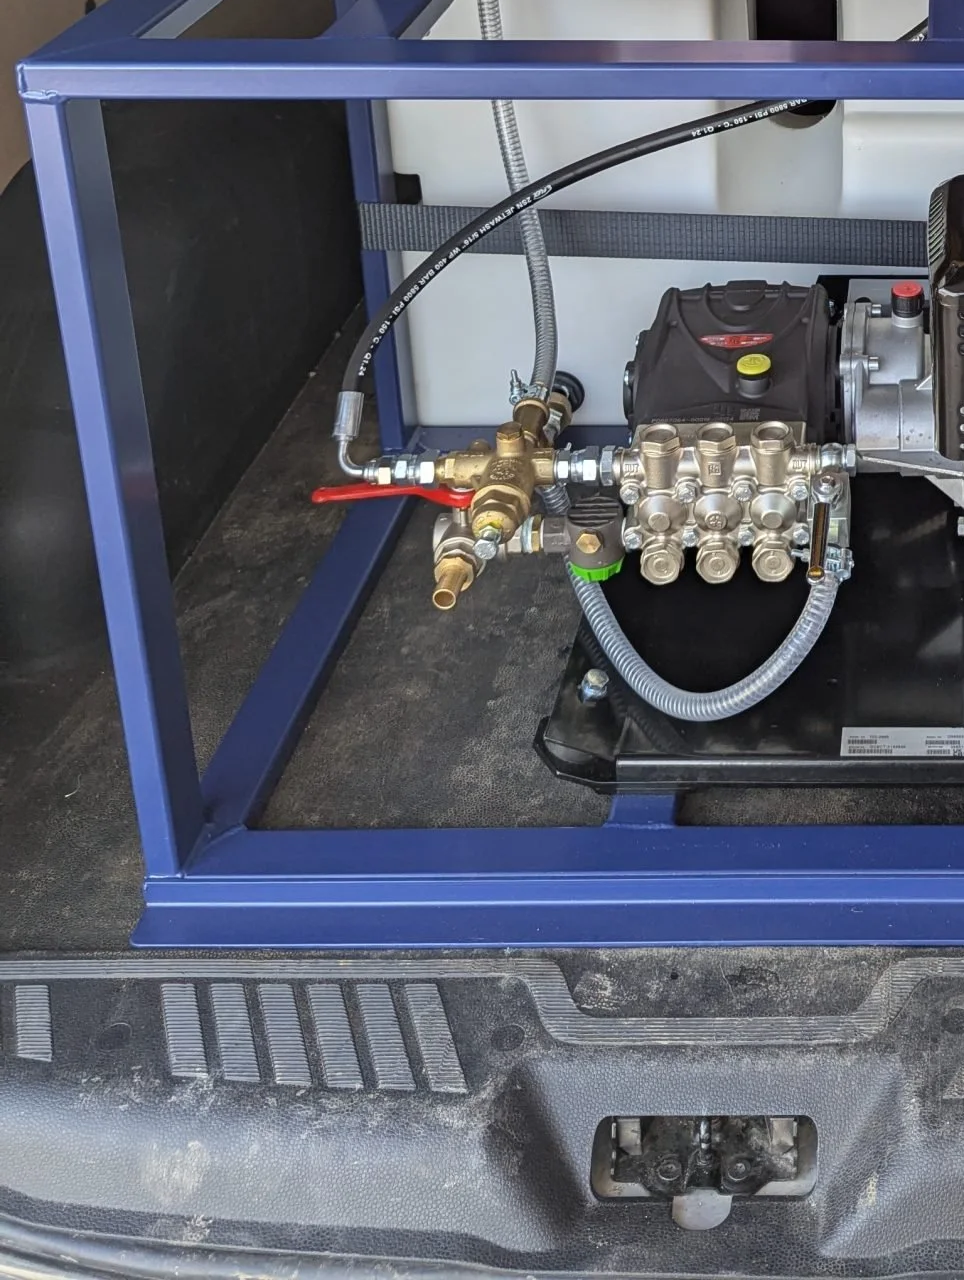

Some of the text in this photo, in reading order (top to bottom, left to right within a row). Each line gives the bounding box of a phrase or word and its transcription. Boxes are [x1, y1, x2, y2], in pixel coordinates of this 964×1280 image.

[754, 110, 769, 119] PSI
[769, 104, 788, 114] 5800
[733, 115, 748, 125] 150
[691, 126, 714, 137] Q1.24
[515, 196, 532, 210] 2SN
[479, 206, 516, 235] JETWASH
[461, 231, 480, 249] 5/16"
[449, 246, 461, 259] WP
[434, 257, 447, 271] 400
[418, 269, 435, 286] BAR
[403, 285, 420, 302] 5800
[392, 301, 405, 316] PSI
[378, 319, 391, 335] 150
[358, 352, 372, 376] Q1.24
